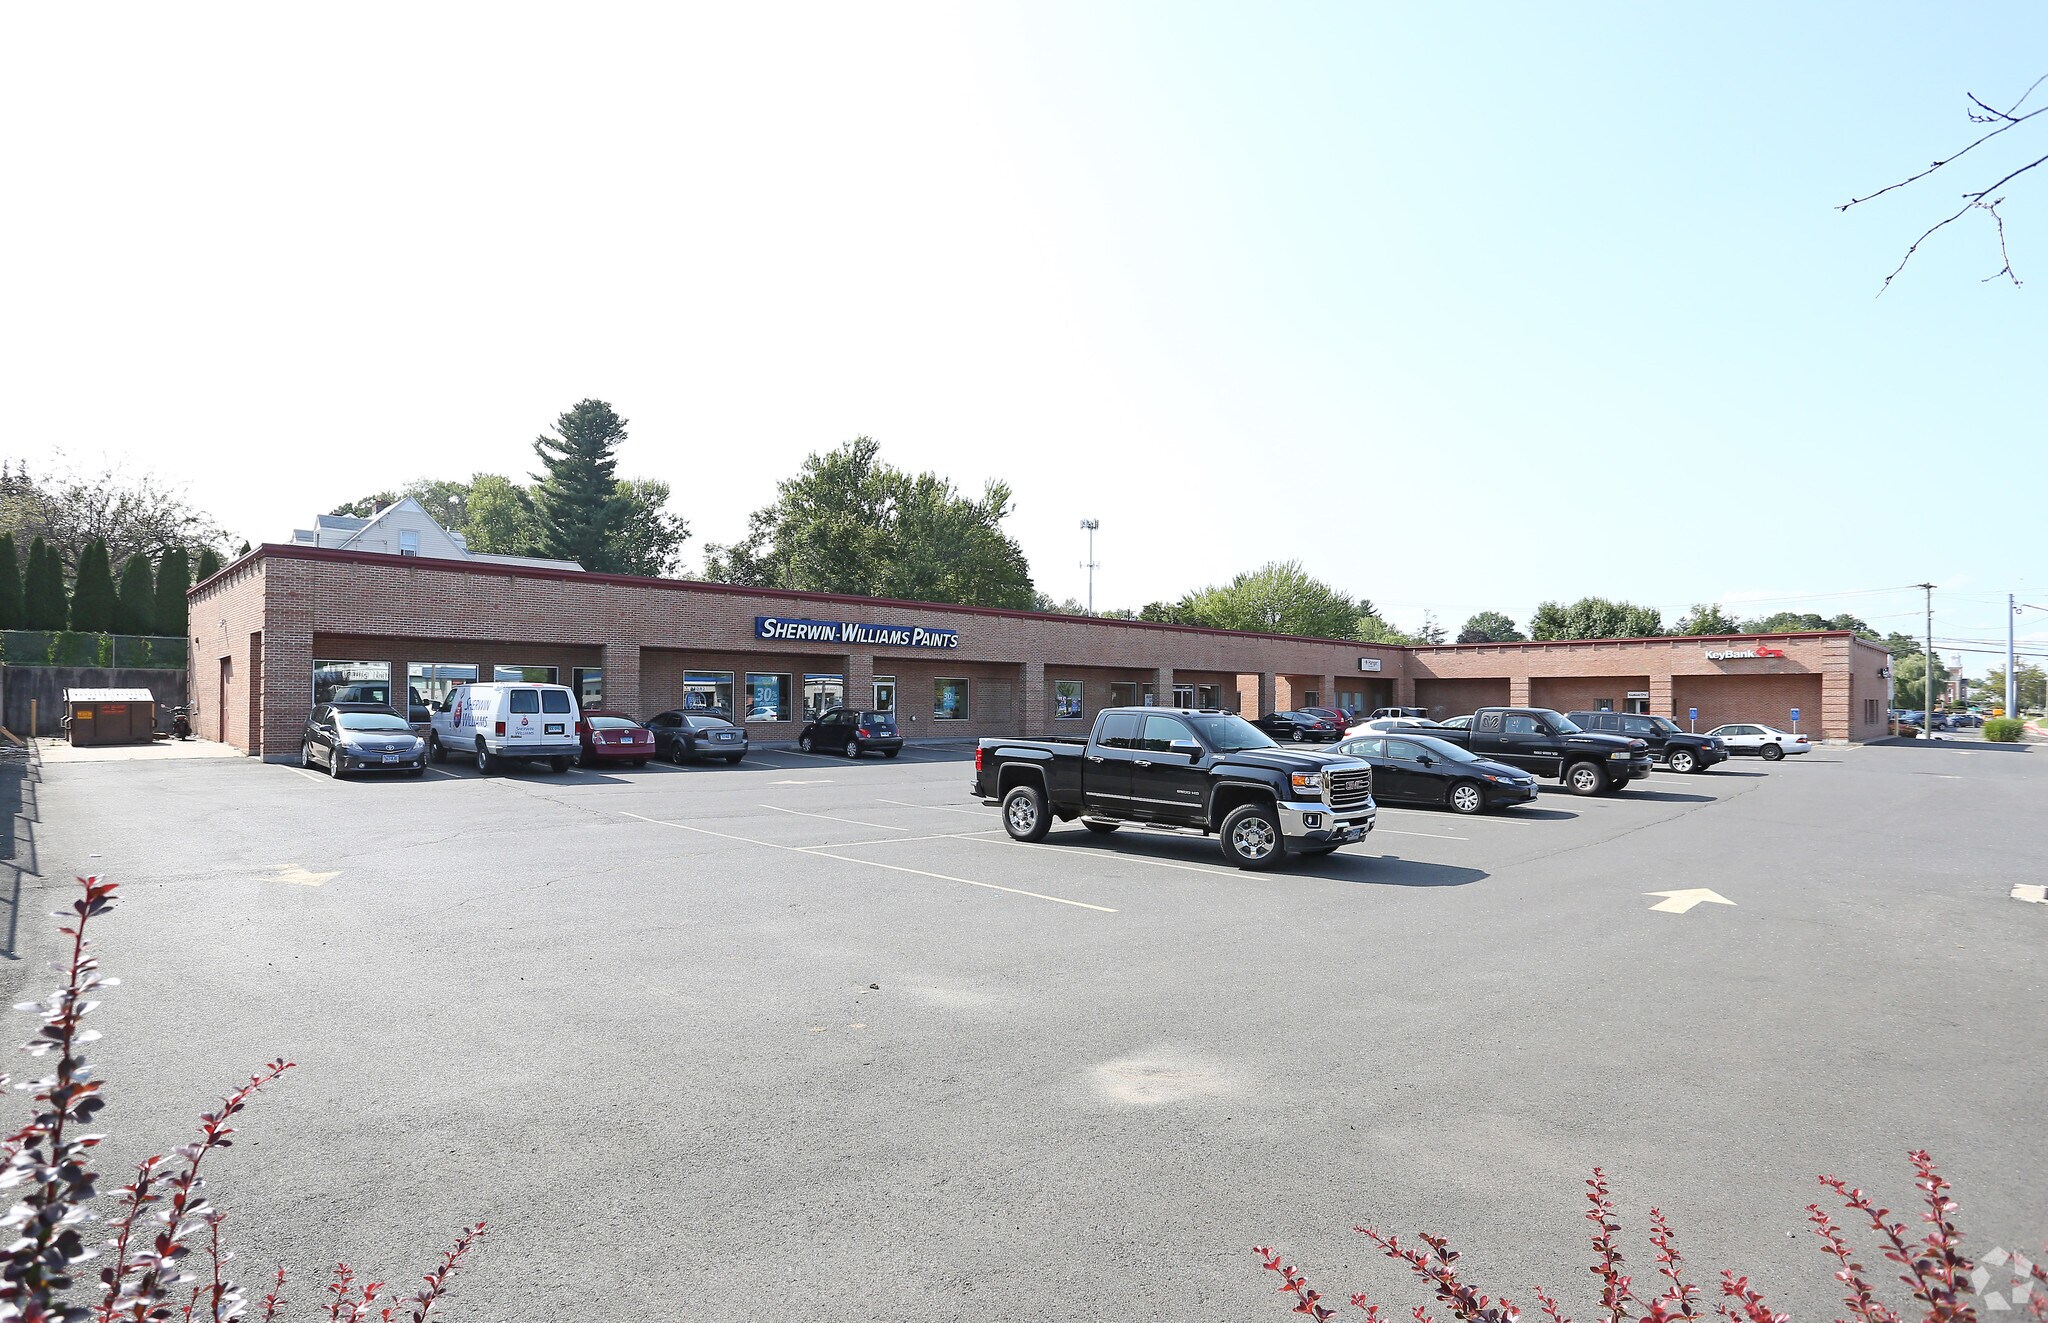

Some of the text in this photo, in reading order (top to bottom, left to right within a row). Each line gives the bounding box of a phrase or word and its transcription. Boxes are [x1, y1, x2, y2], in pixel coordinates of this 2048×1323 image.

[912, 627, 959, 648] PAINTS
[1705, 649, 1755, 660] KeyBank
[462, 713, 489, 728] WILLIAMS
